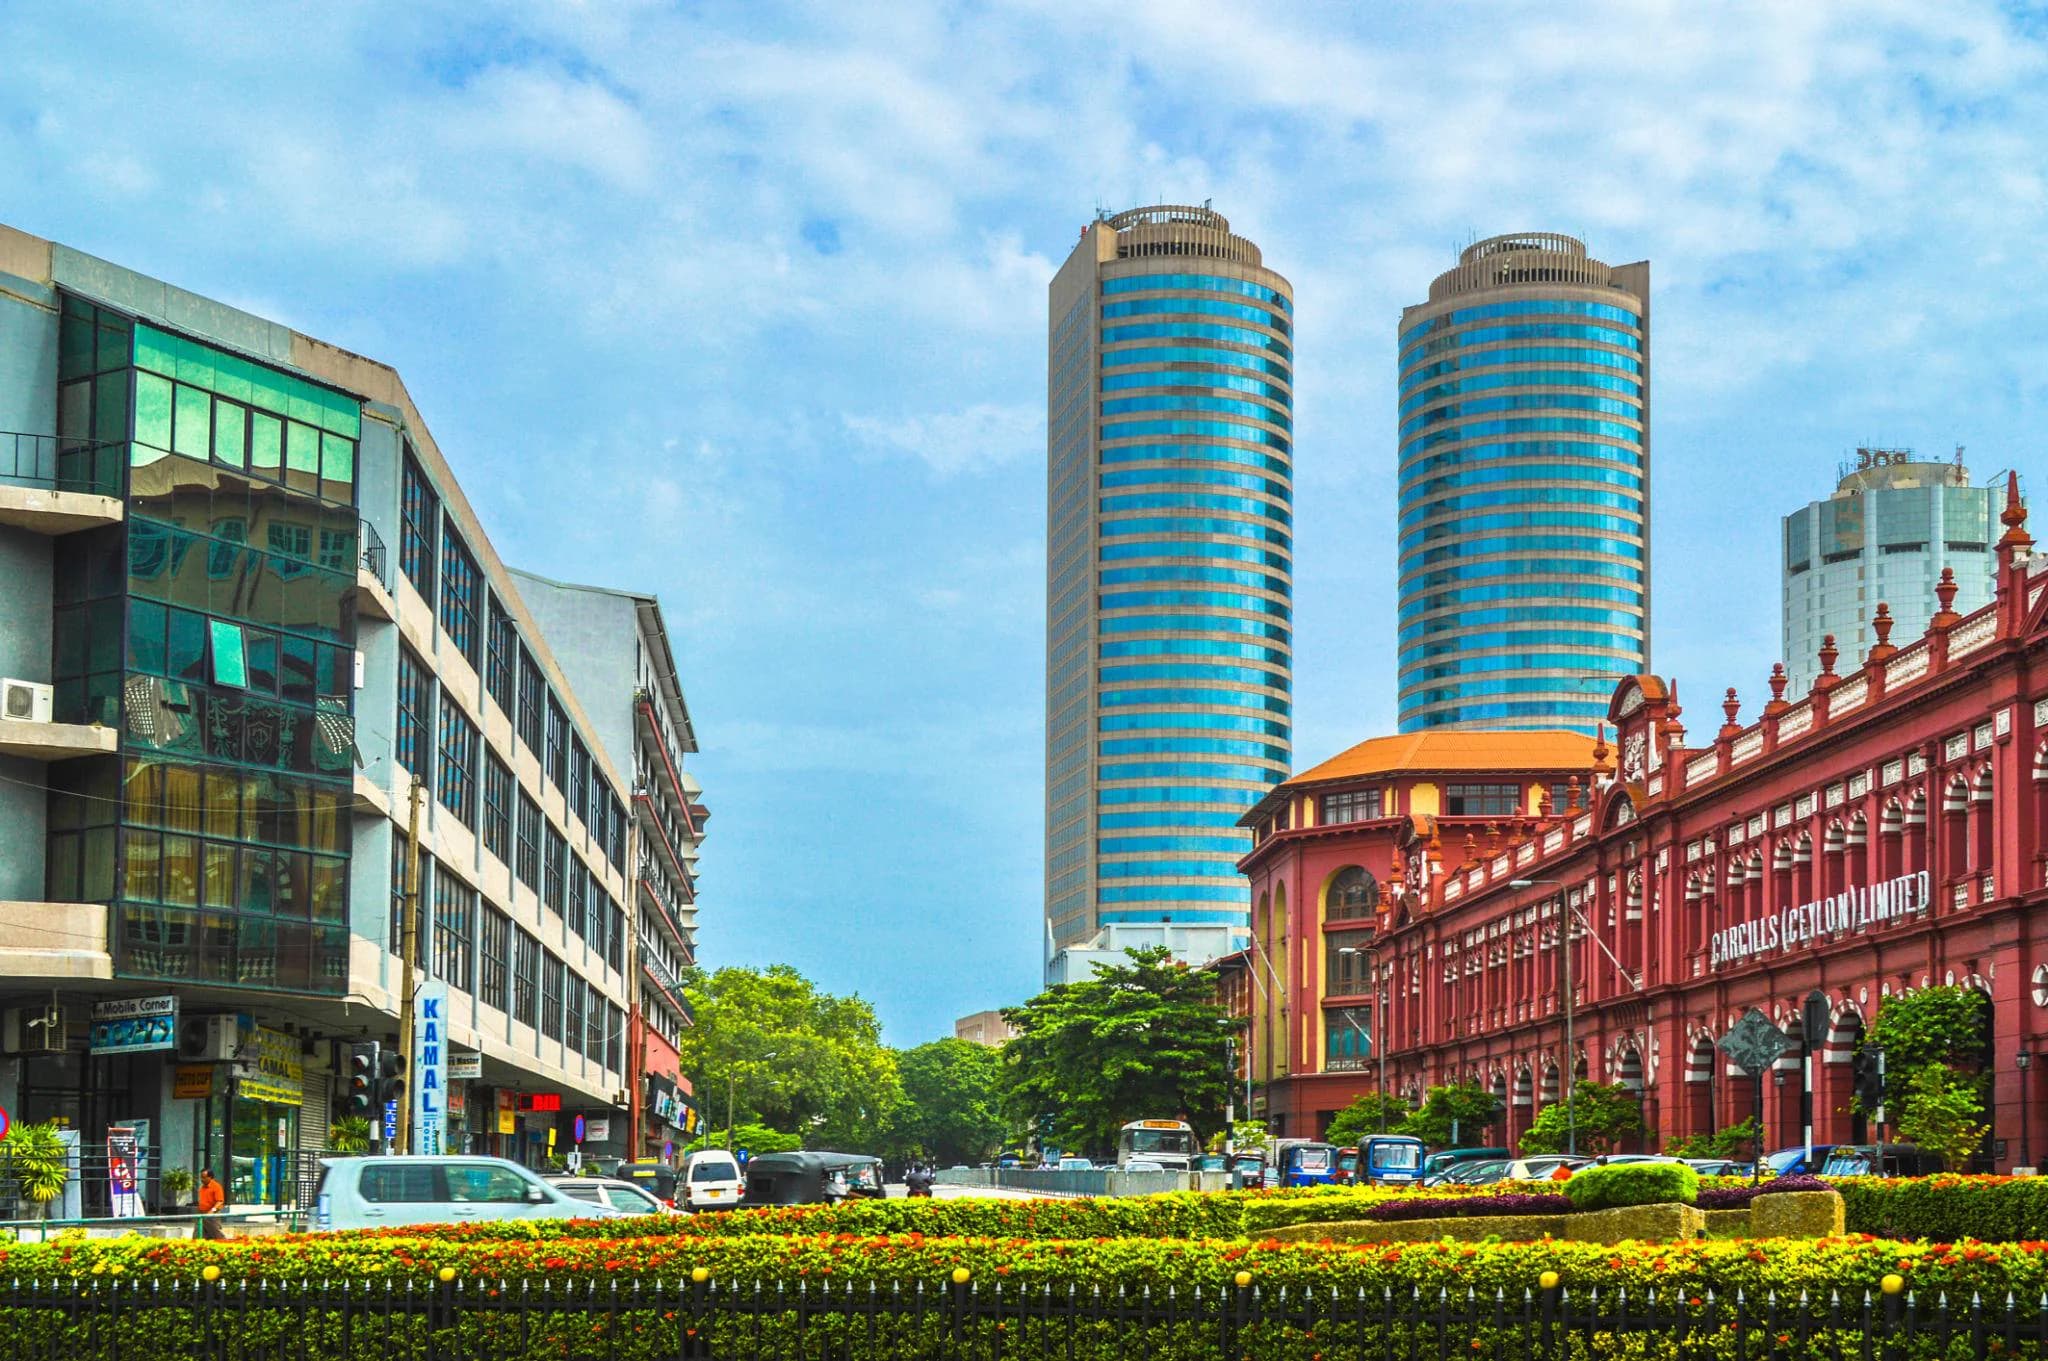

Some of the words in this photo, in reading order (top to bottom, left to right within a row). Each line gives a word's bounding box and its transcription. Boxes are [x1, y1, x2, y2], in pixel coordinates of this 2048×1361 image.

[1711, 914, 1778, 964] CARGILLS
[1781, 884, 1856, 953] (CEYLON)
[1859, 870, 1930, 925] LIMITED
[104, 1001, 136, 1015] Mobile
[140, 998, 171, 1012] Corner
[423, 998, 439, 1113] KAMAL
